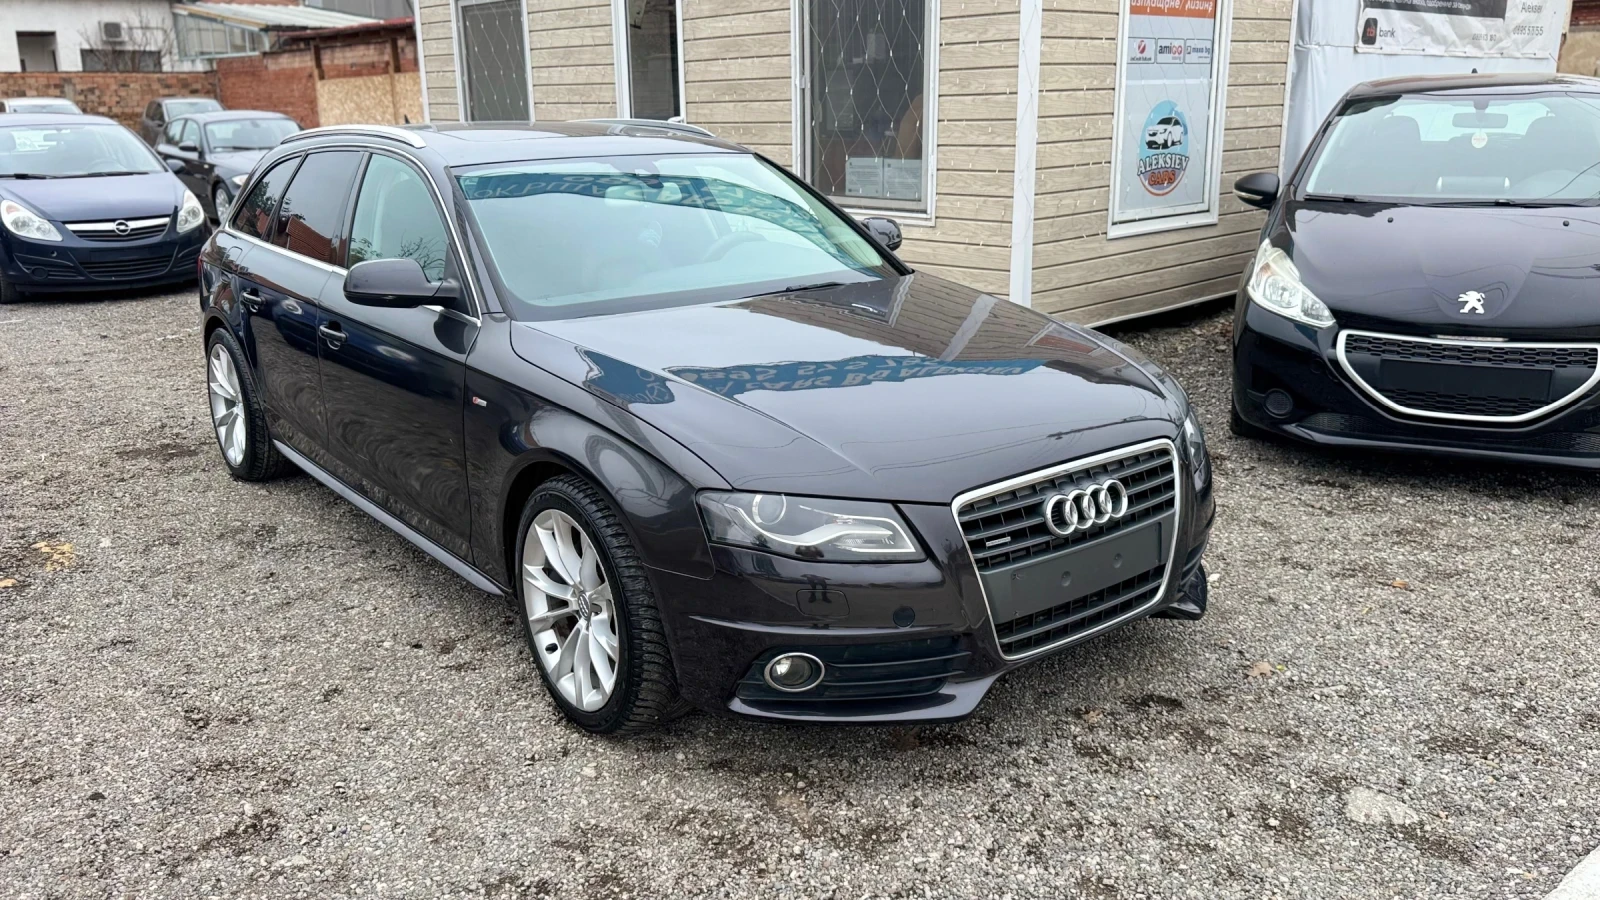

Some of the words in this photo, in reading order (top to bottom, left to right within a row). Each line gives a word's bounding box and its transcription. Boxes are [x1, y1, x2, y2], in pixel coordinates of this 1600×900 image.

[1379, 27, 1396, 38] bank
[1137, 152, 1189, 176] ALEKSIEV
[1148, 170, 1176, 186] CARS
